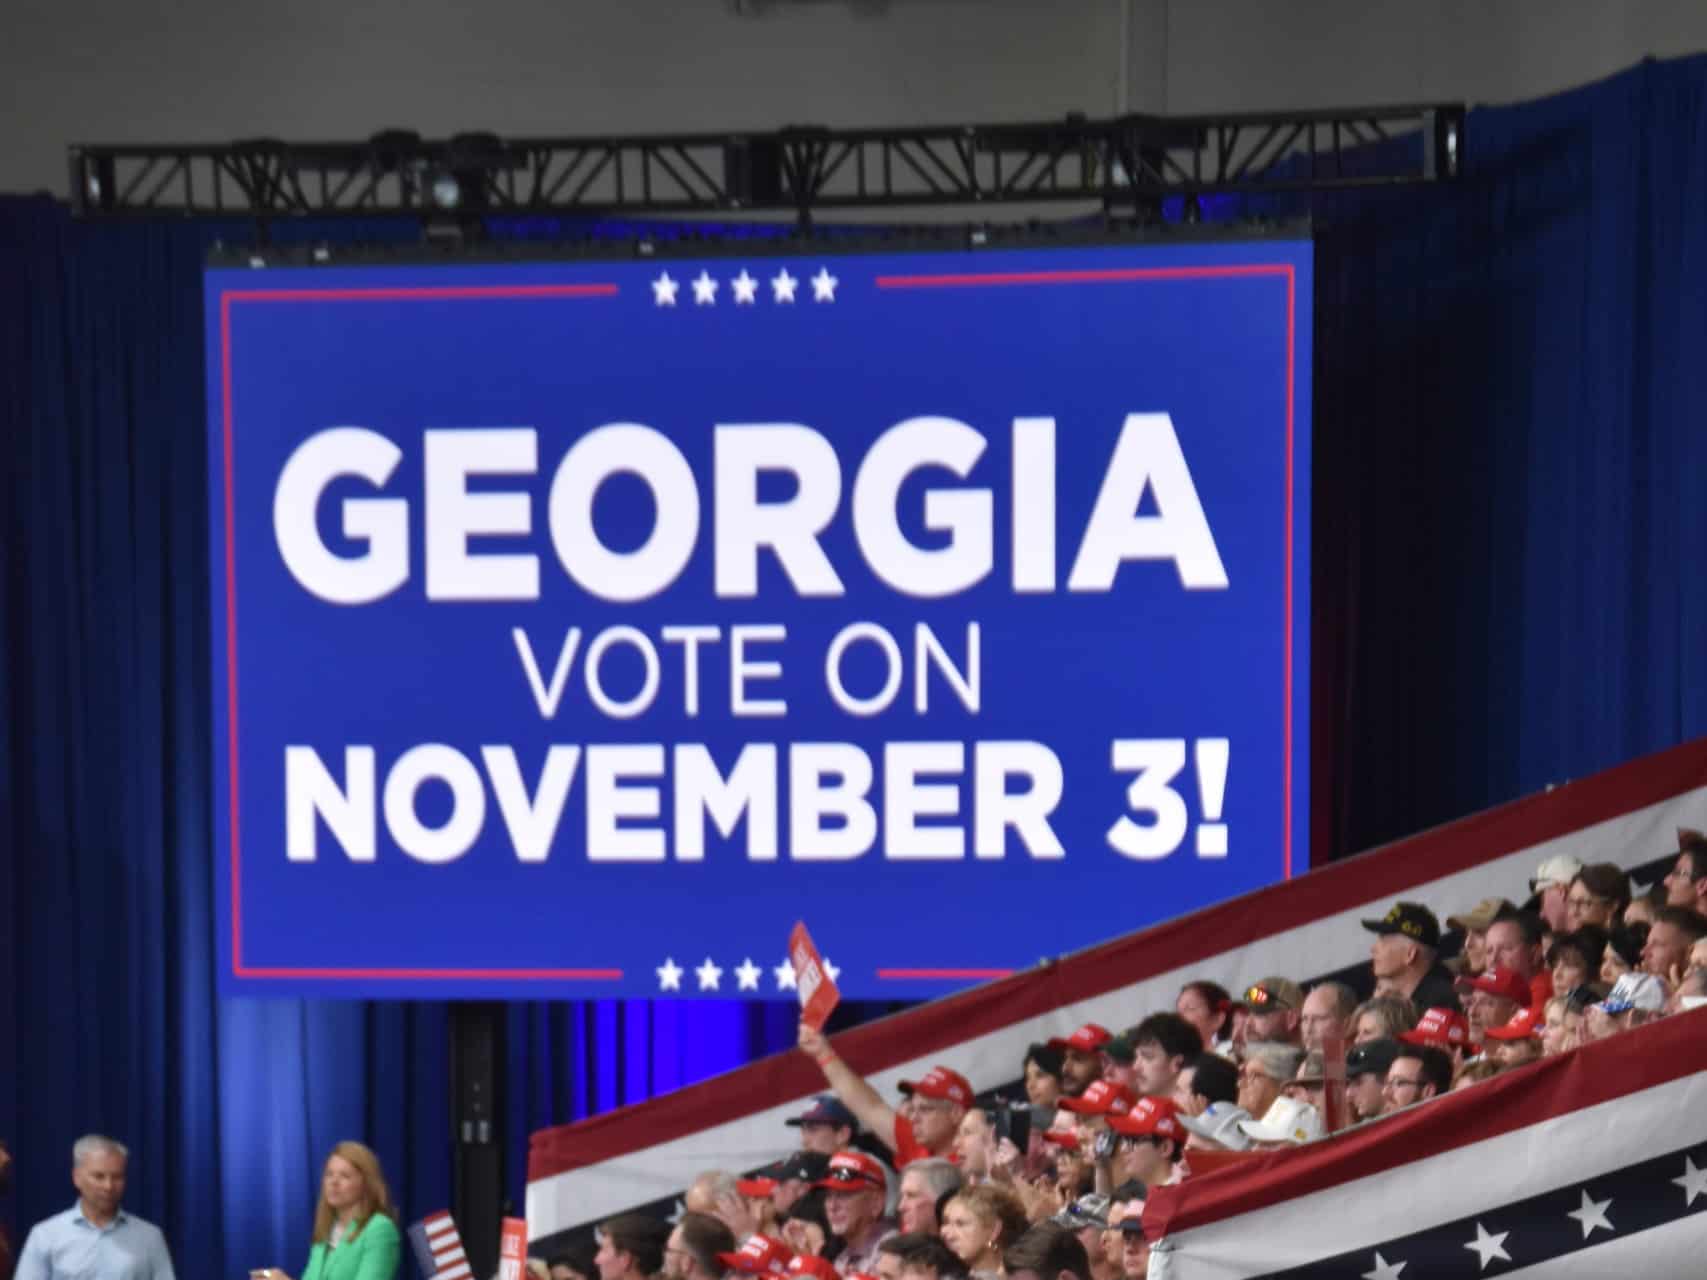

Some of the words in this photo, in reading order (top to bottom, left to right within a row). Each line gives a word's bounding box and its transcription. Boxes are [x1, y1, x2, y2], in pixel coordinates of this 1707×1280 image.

[273, 411, 1229, 605] GEORGIA
[513, 624, 788, 718] VOTE
[825, 621, 981, 716] ON
[284, 740, 1066, 864] NOVEMBER
[1106, 737, 1230, 860] 3!
